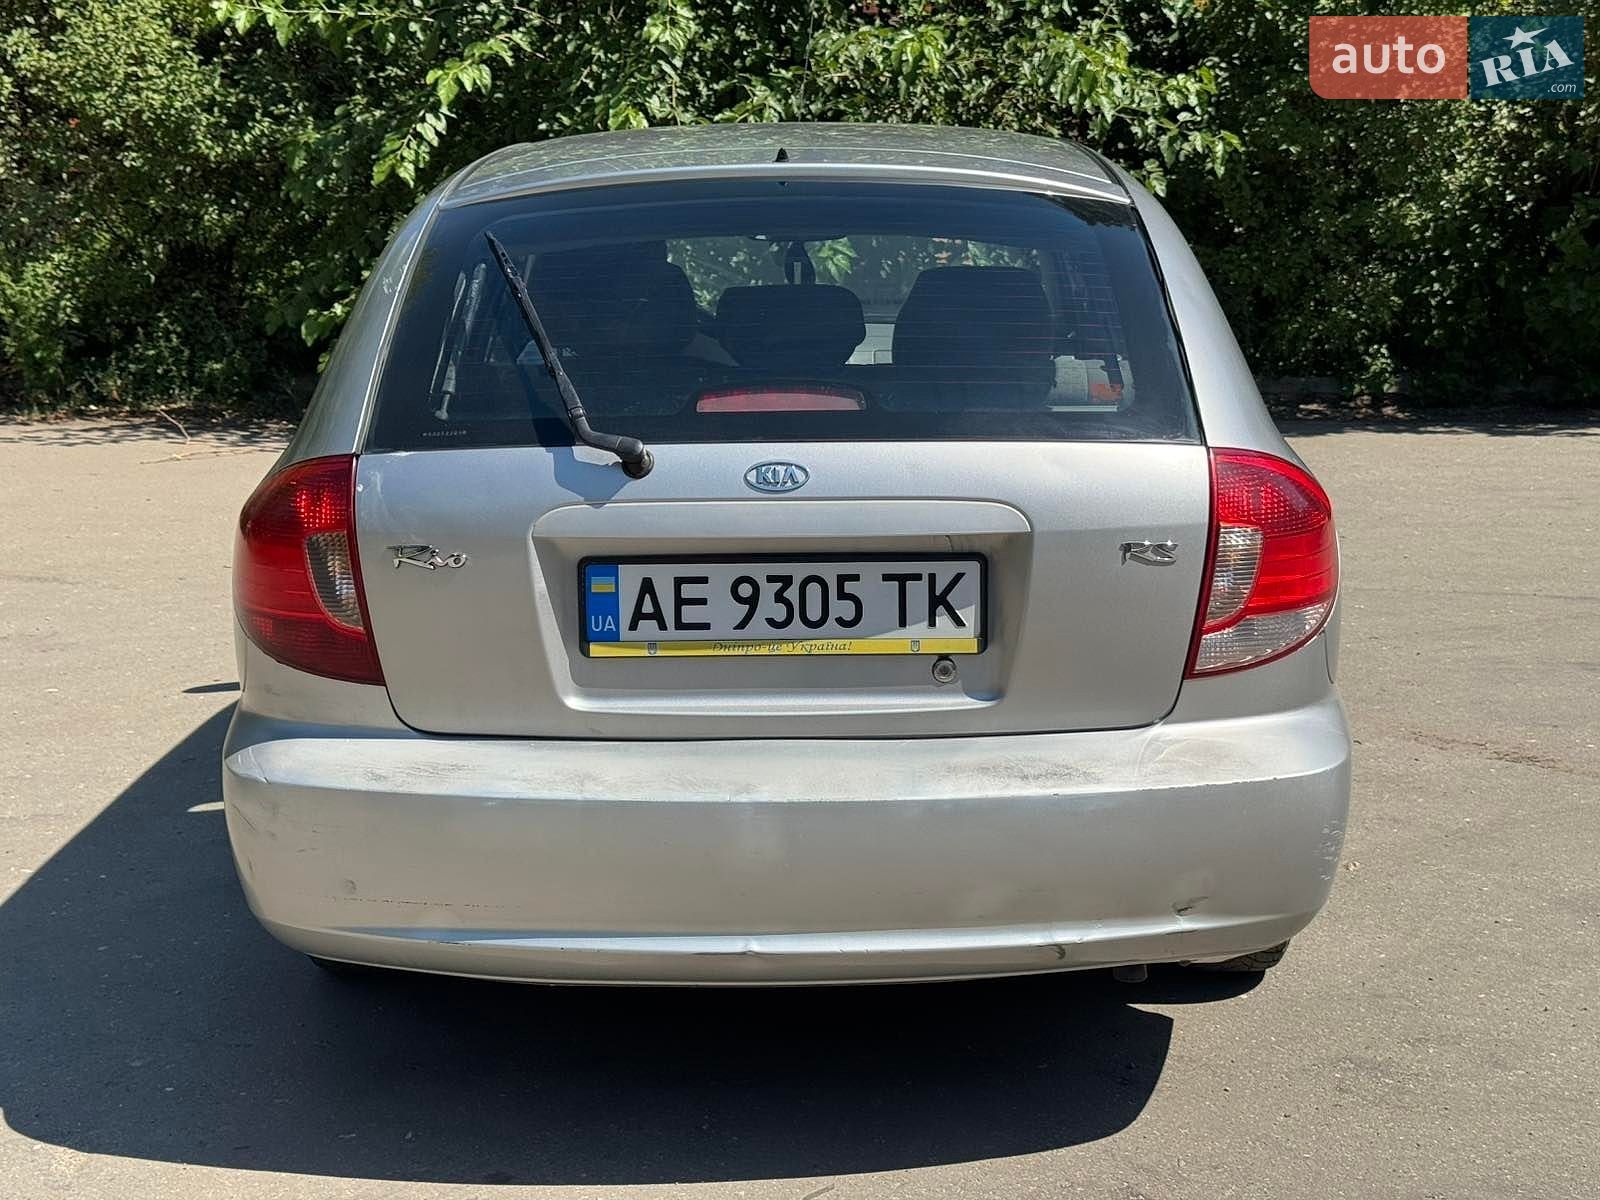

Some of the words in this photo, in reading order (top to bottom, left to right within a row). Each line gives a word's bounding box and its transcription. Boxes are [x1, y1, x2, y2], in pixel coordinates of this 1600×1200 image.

[755, 465, 800, 486] KIA
[1119, 541, 1178, 567] RS
[628, 576, 711, 632] AE
[730, 573, 864, 630] 9305
[881, 572, 967, 629] TK
[591, 615, 616, 632] UA
